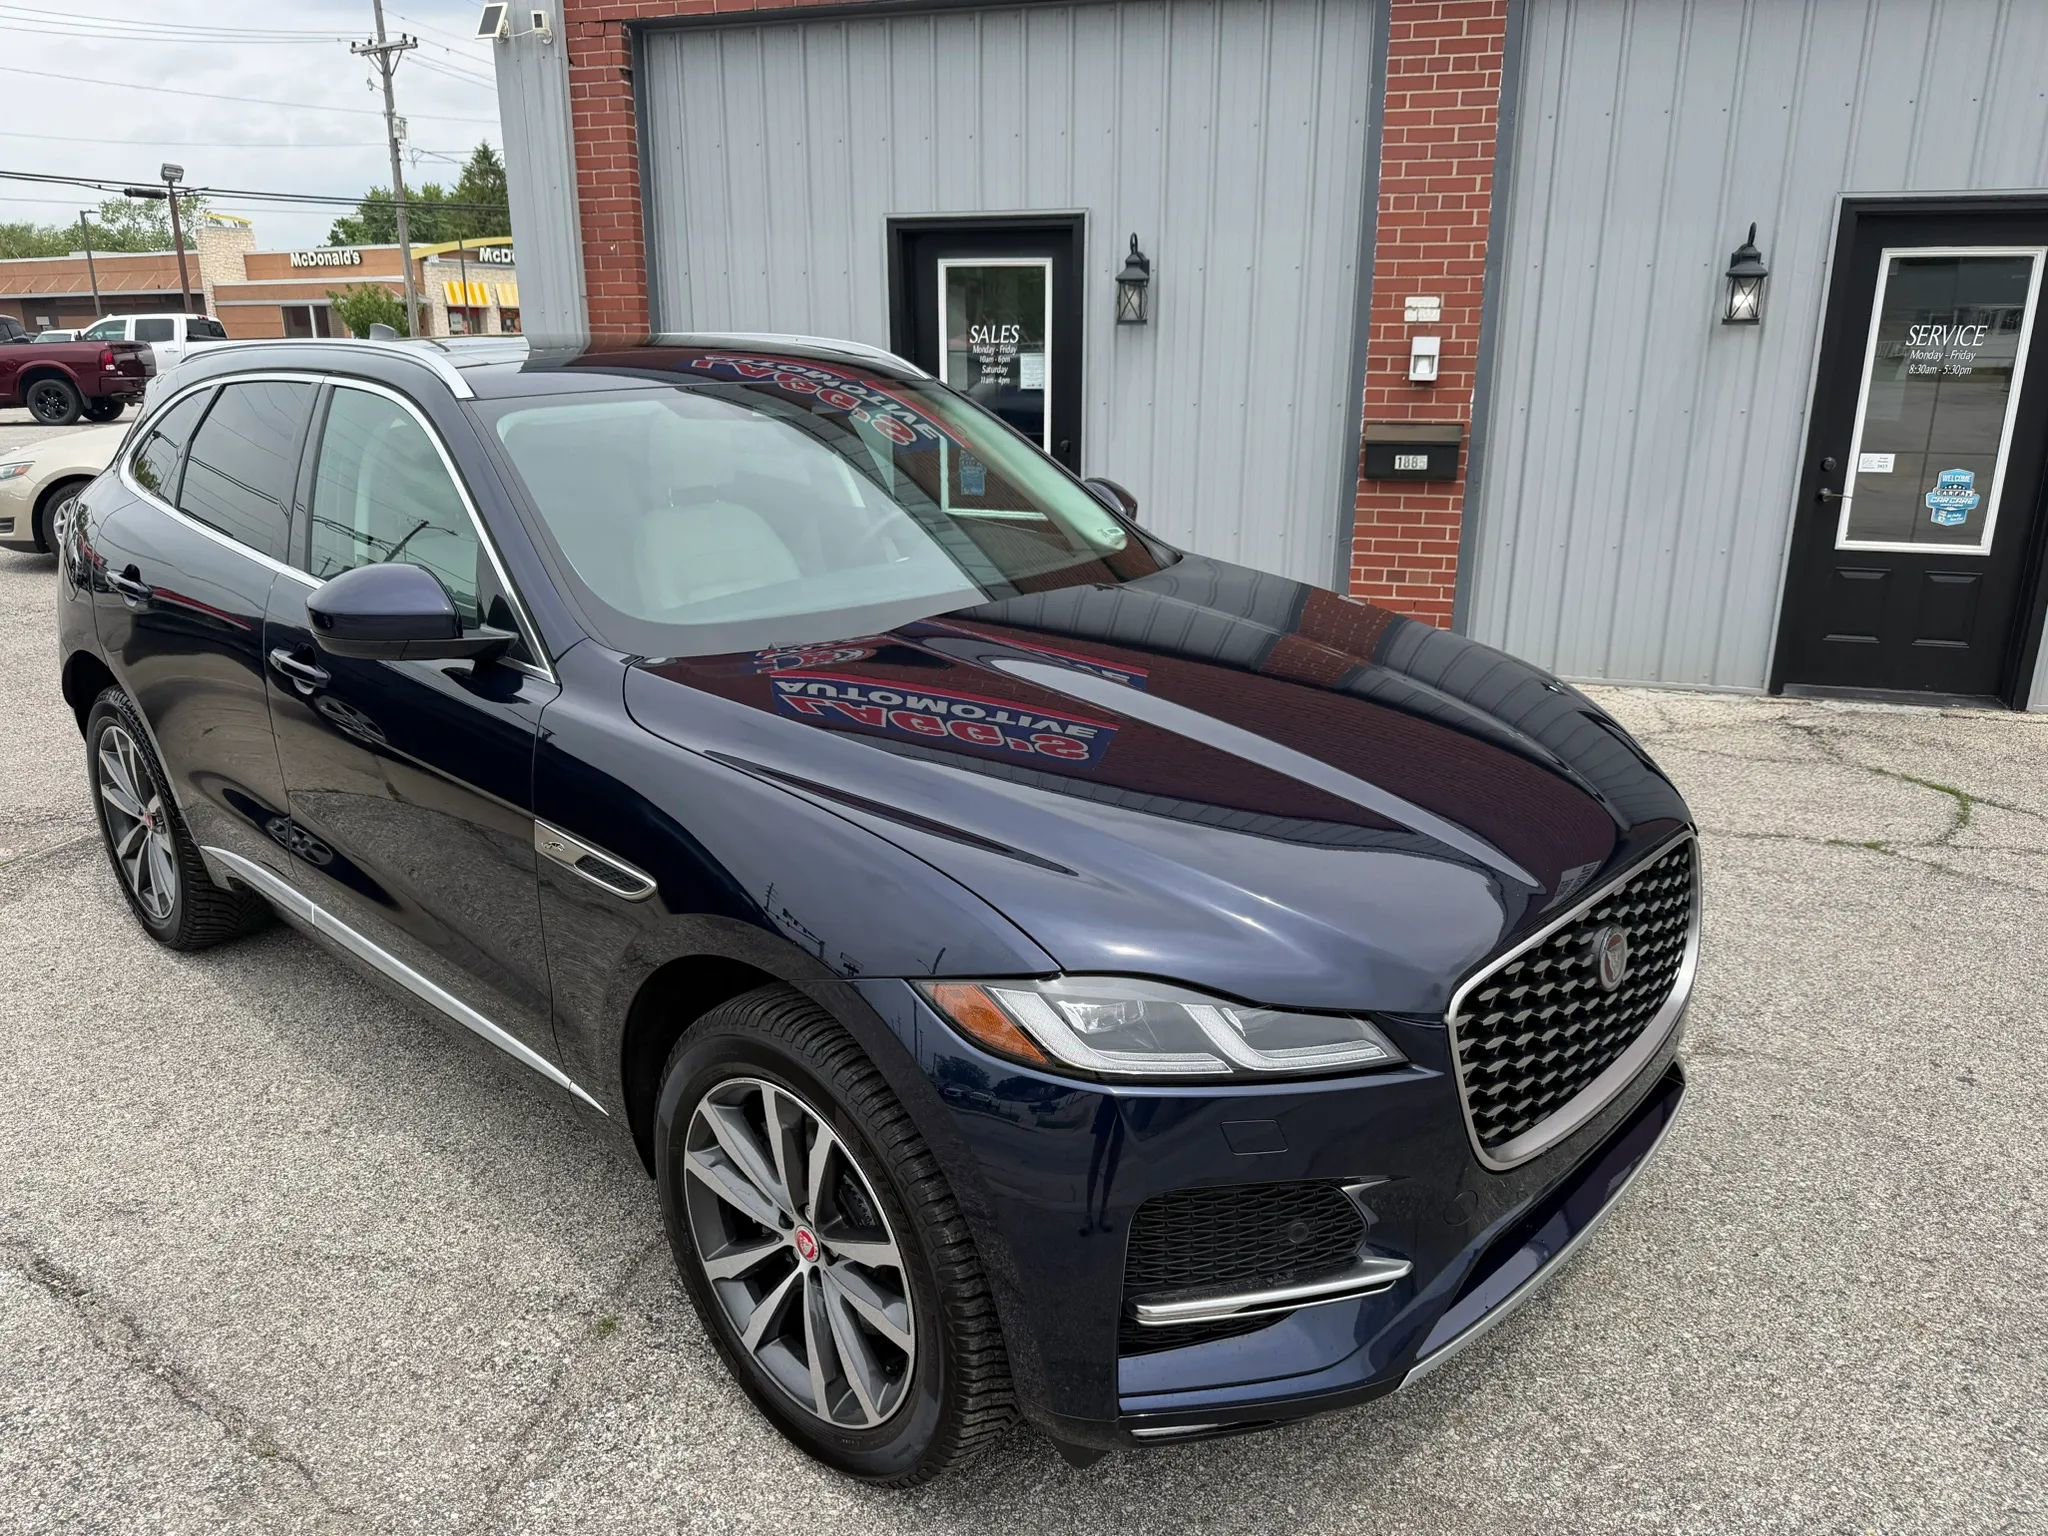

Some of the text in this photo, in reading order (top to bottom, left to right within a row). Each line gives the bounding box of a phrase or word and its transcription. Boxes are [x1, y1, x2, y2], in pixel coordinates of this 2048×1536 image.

[290, 249, 361, 267] McDonald's
[969, 324, 1020, 343] SALES
[1905, 324, 1988, 346] SERVICE
[972, 345, 995, 356] Monday
[999, 345, 1017, 356] Friday
[1909, 349, 1944, 362] Monday
[1950, 349, 1977, 363] Friday
[979, 355, 994, 363] 10am
[997, 355, 1011, 364] 6pm
[981, 365, 1008, 375] Saturday
[1908, 363, 1937, 375] 8:30am
[1942, 364, 1972, 377] 5:30pm
[980, 376, 994, 384] 11am
[997, 376, 1011, 386] 4pm
[1942, 474, 1971, 482] WELCOME
[1949, 497, 1975, 505] CARE
